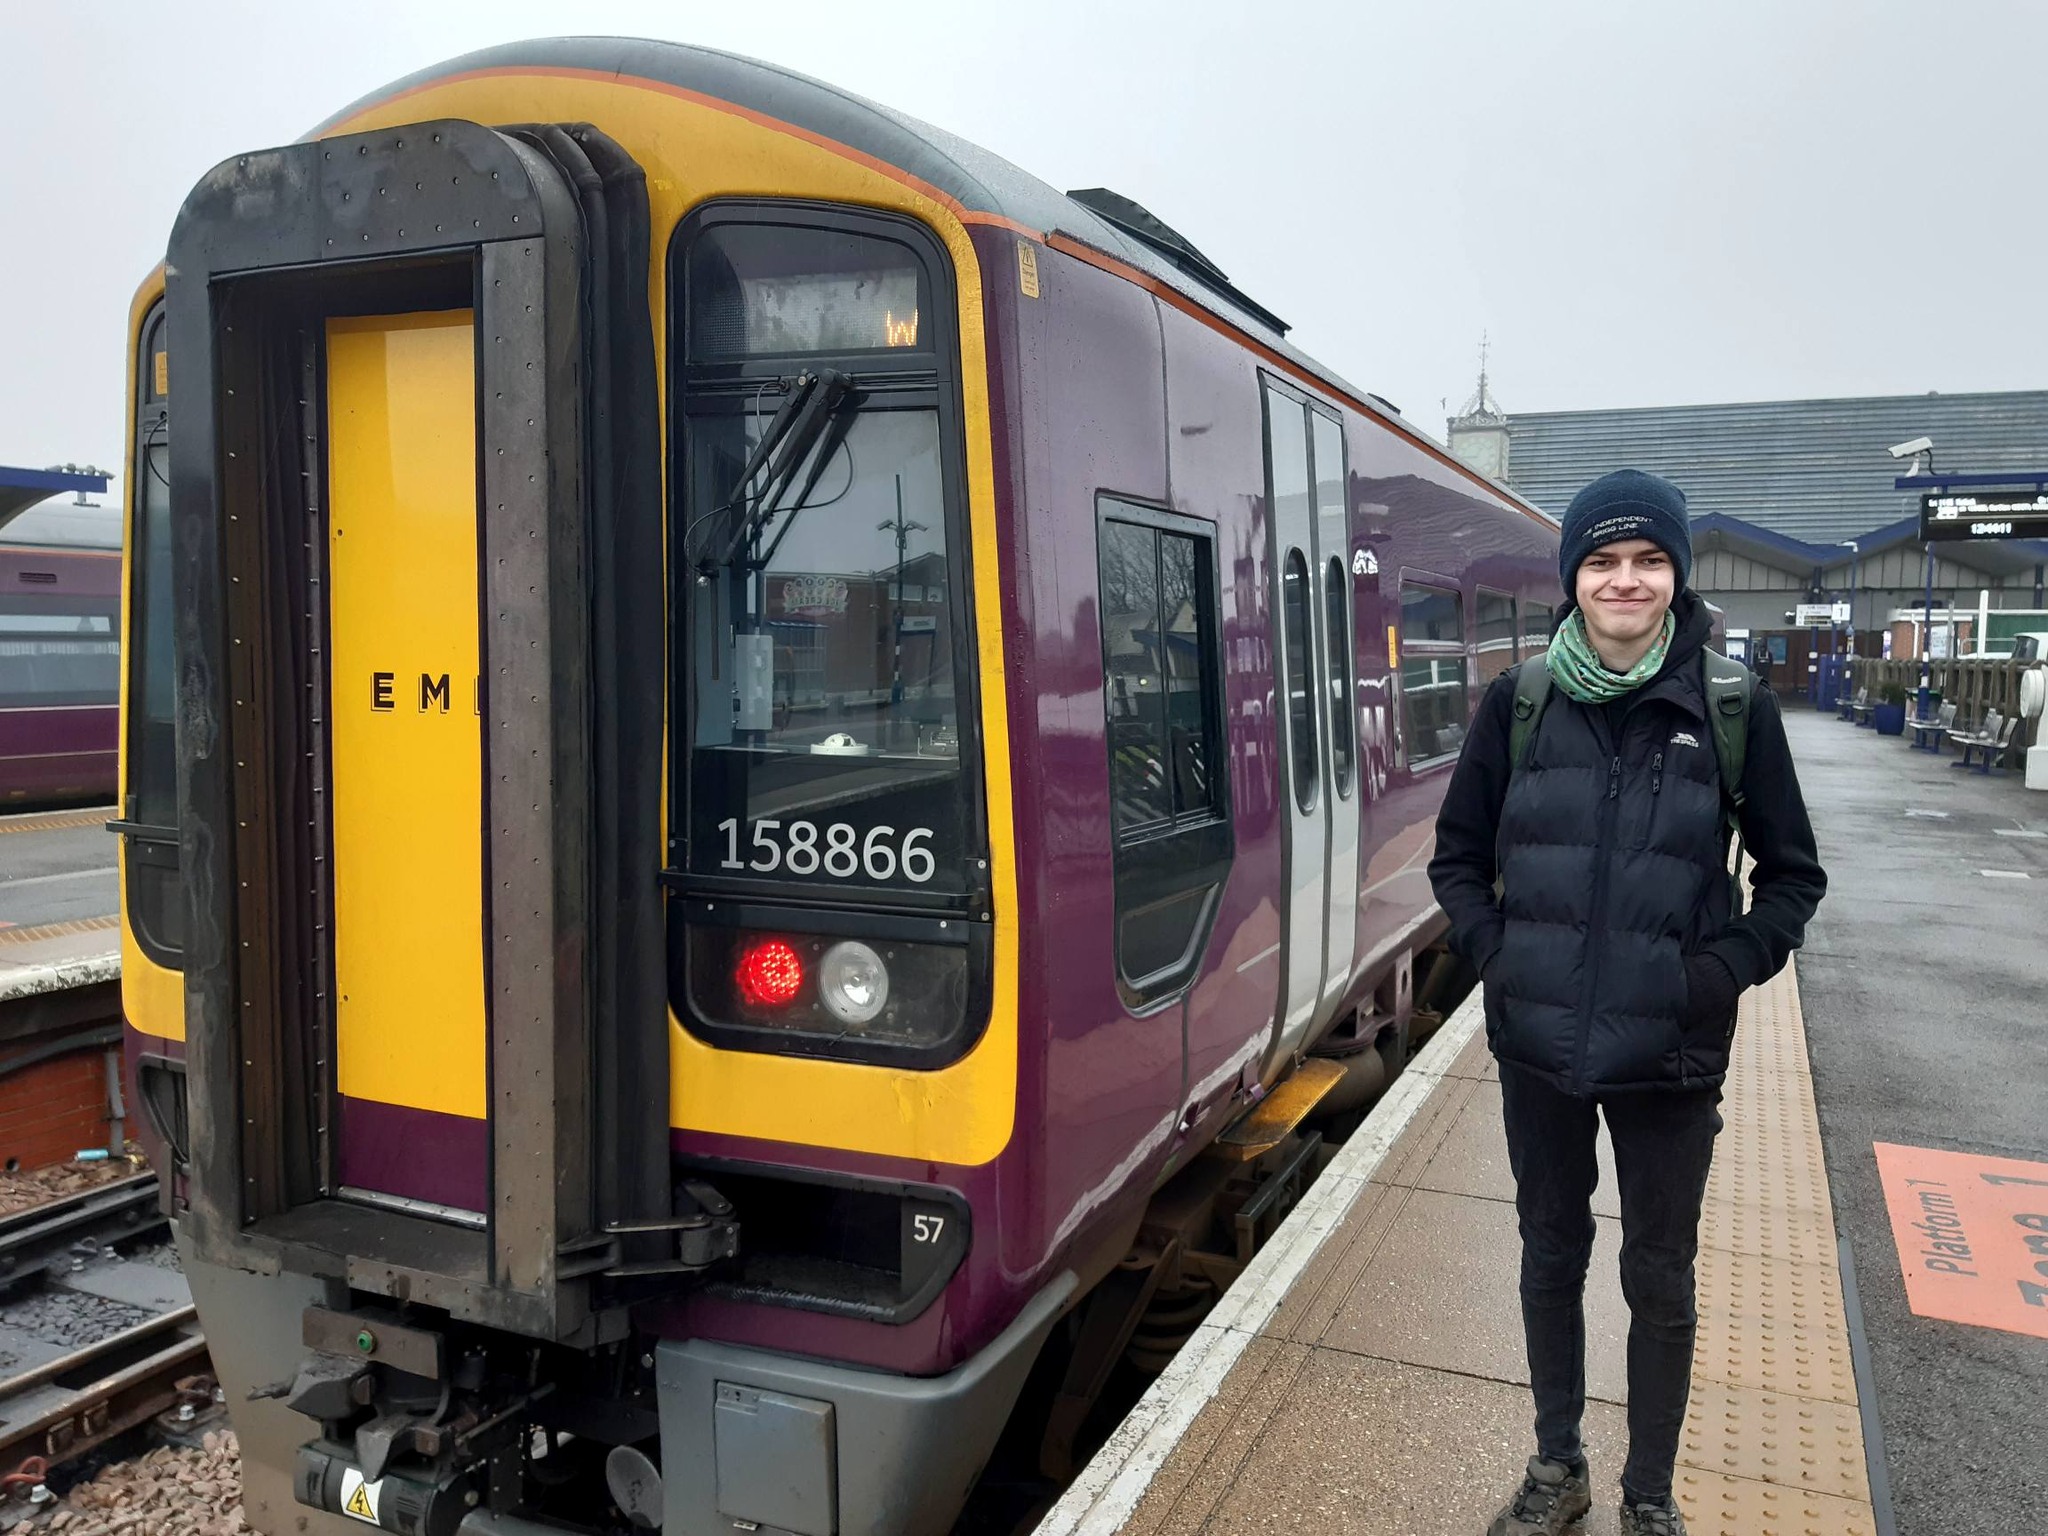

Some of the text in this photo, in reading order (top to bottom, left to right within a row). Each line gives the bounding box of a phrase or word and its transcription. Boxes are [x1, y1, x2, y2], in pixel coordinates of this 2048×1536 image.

[1592, 522, 1640, 538] BRIGG LINE
[1594, 515, 1653, 530] INDEPENDENT
[1838, 606, 1843, 618] 1
[1669, 738, 1699, 748] TRESPASS
[718, 817, 936, 883] 158866
[913, 1214, 944, 1244] 57
[1904, 1178, 1979, 1278] Platform 1
